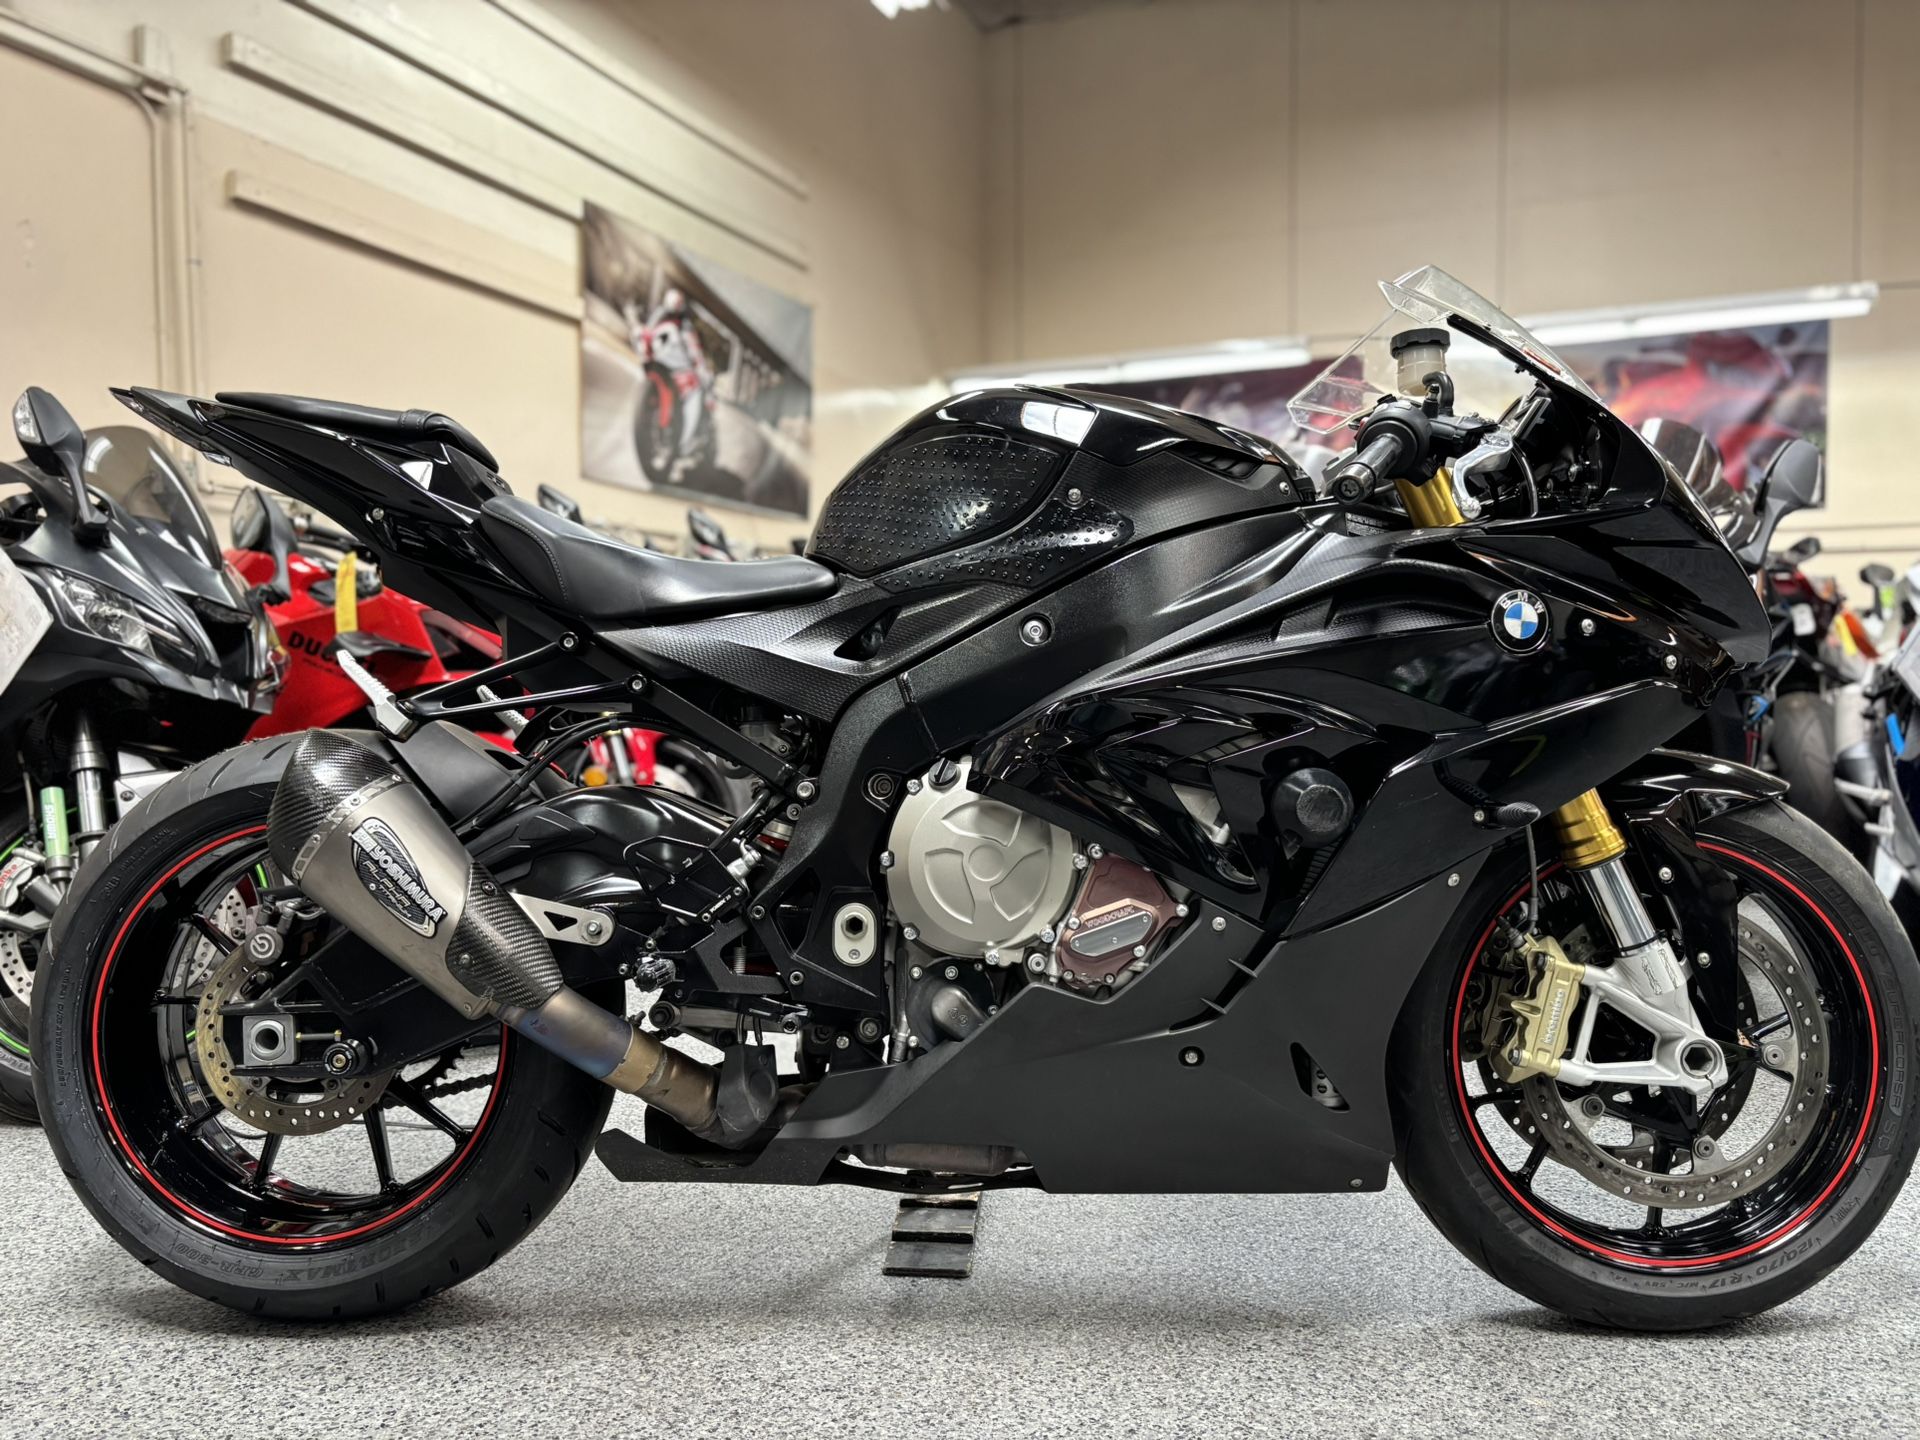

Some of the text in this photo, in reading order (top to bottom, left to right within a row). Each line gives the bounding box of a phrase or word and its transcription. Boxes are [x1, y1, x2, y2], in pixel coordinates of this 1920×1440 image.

[1499, 591, 1545, 614] BMW
[362, 860, 411, 907] ALPHA
[368, 844, 444, 922] YOSHIMURA
[1543, 989, 1565, 1045] brembo
[1756, 1237, 1813, 1276] 120/70
